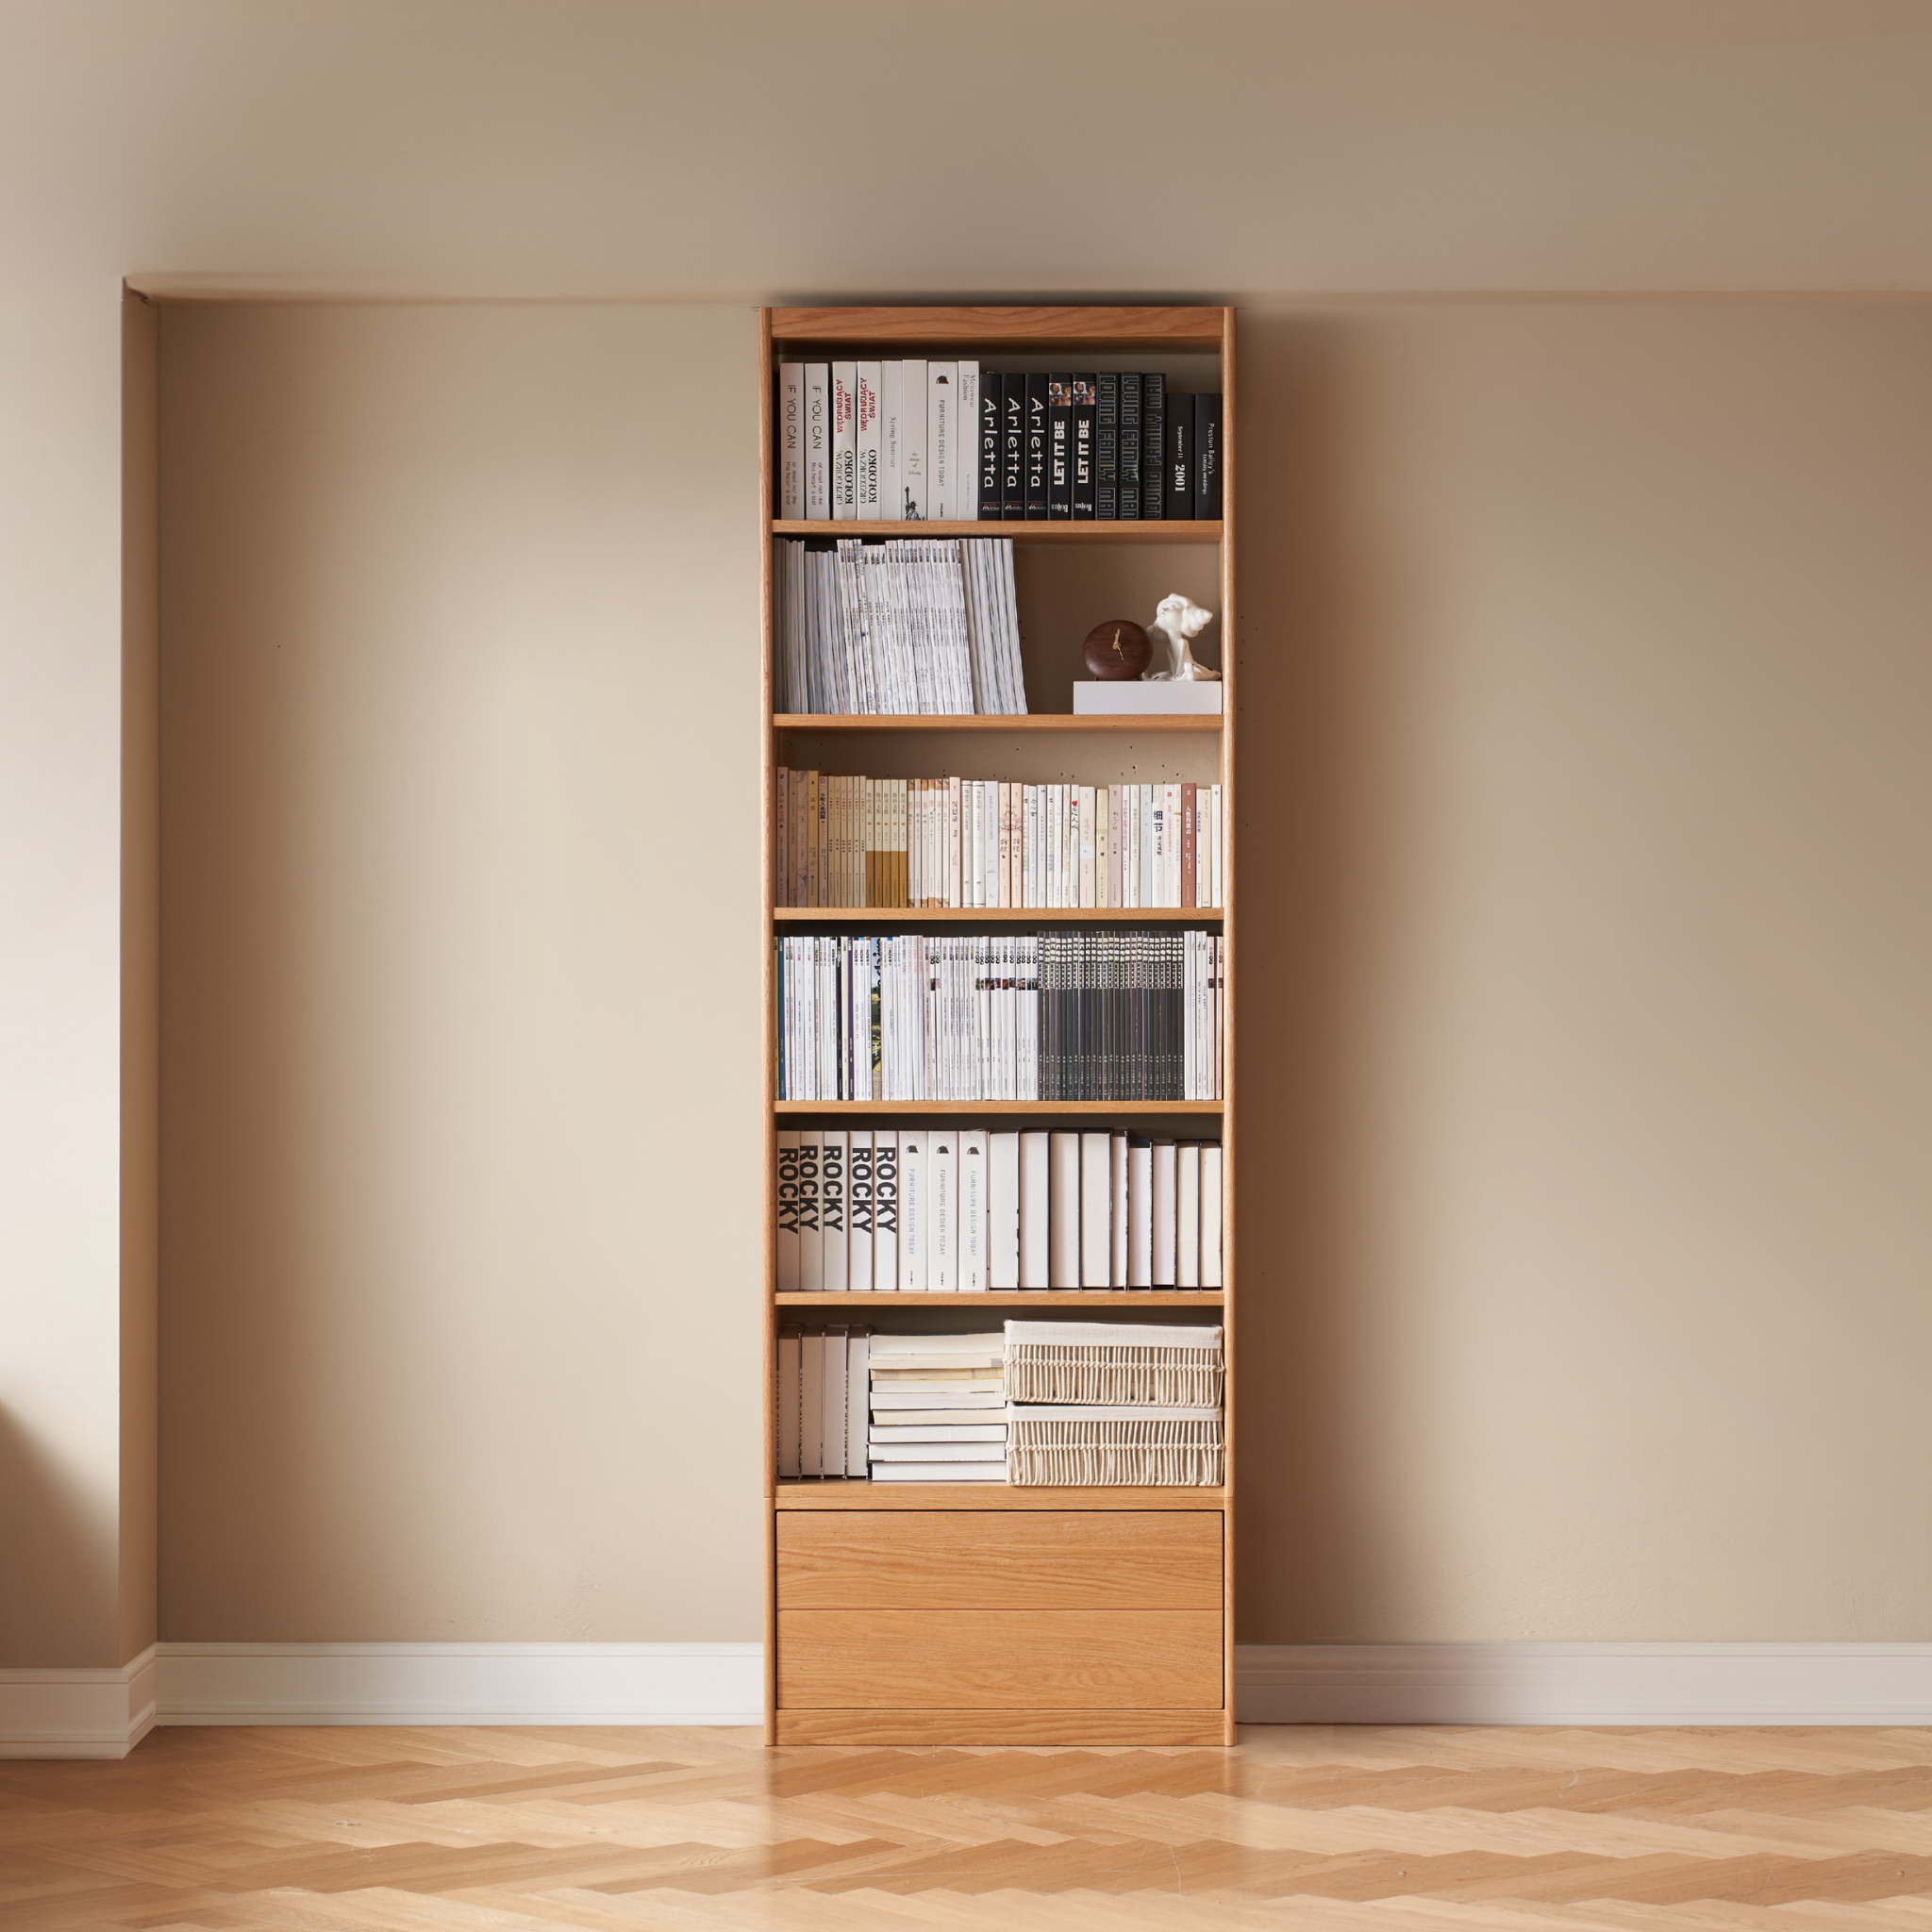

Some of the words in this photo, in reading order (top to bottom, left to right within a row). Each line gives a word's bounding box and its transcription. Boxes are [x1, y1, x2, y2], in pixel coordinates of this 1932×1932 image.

[787, 385, 796, 393] IF
[812, 385, 822, 394] IF
[1145, 375, 1162, 408] MAN
[787, 398, 796, 421] YOU
[812, 399, 822, 421] YOU
[787, 425, 796, 449] CAN
[812, 426, 822, 449] CAN
[889, 417, 897, 439] Spring
[1031, 397, 1045, 488] Arletta
[1055, 421, 1065, 440] BE
[1078, 420, 1090, 439] BE
[1145, 414, 1162, 465] FAMILY
[984, 398, 998, 489] Arletta
[1008, 398, 1022, 488] Arletta
[1055, 442, 1065, 457] IT
[1078, 441, 1090, 456] IT
[1099, 430, 1116, 481] FAMILY
[1122, 430, 1139, 481] FAMILY
[868, 449, 877, 503] KOŁODKO
[1055, 458, 1065, 485] LET
[1078, 458, 1090, 484] LET
[1175, 464, 1186, 491] 2001
[1099, 488, 1116, 519] MAN
[1122, 488, 1139, 519] MAN
[1154, 810, 1163, 833] 细节
[779, 1148, 799, 1235] ROCKY
[800, 1145, 819, 1232] ROCKY
[824, 1145, 843, 1233] ROCKY
[852, 1148, 873, 1235] ROCKY
[876, 1147, 897, 1235] ROCKY
